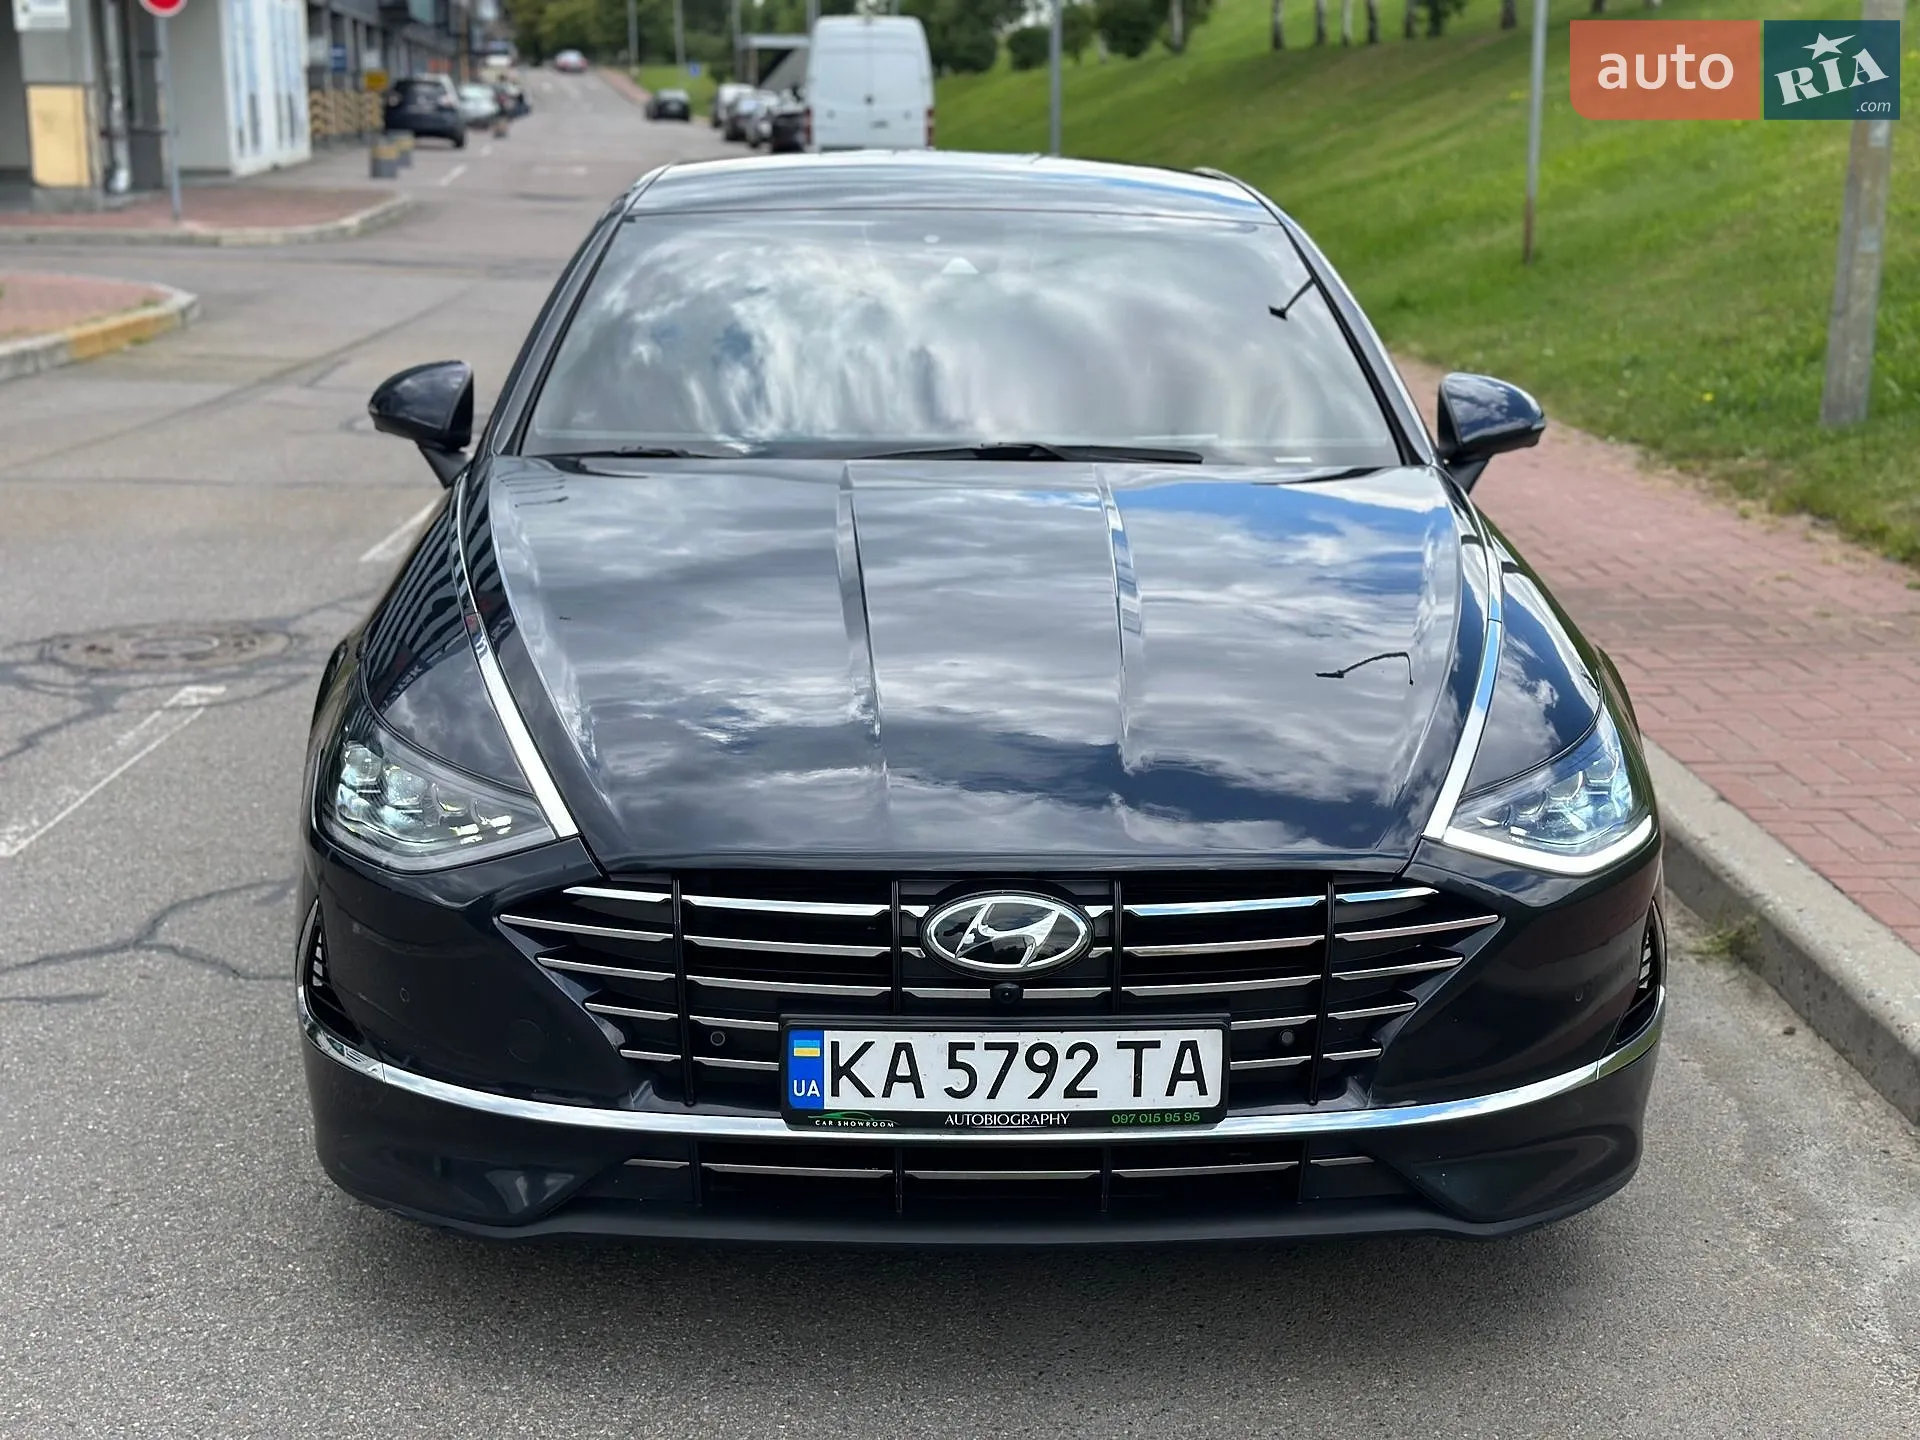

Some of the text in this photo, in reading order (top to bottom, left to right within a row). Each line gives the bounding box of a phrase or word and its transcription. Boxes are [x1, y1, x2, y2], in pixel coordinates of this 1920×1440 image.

[830, 1040, 1209, 1100] KA 5792 TA
[793, 1079, 821, 1098] UA
[815, 1119, 895, 1129] CAR SHOWROOM
[944, 1113, 1071, 1126] AUTOBIOGRAPHY
[1111, 1111, 1201, 1124] 097 015 95 95
